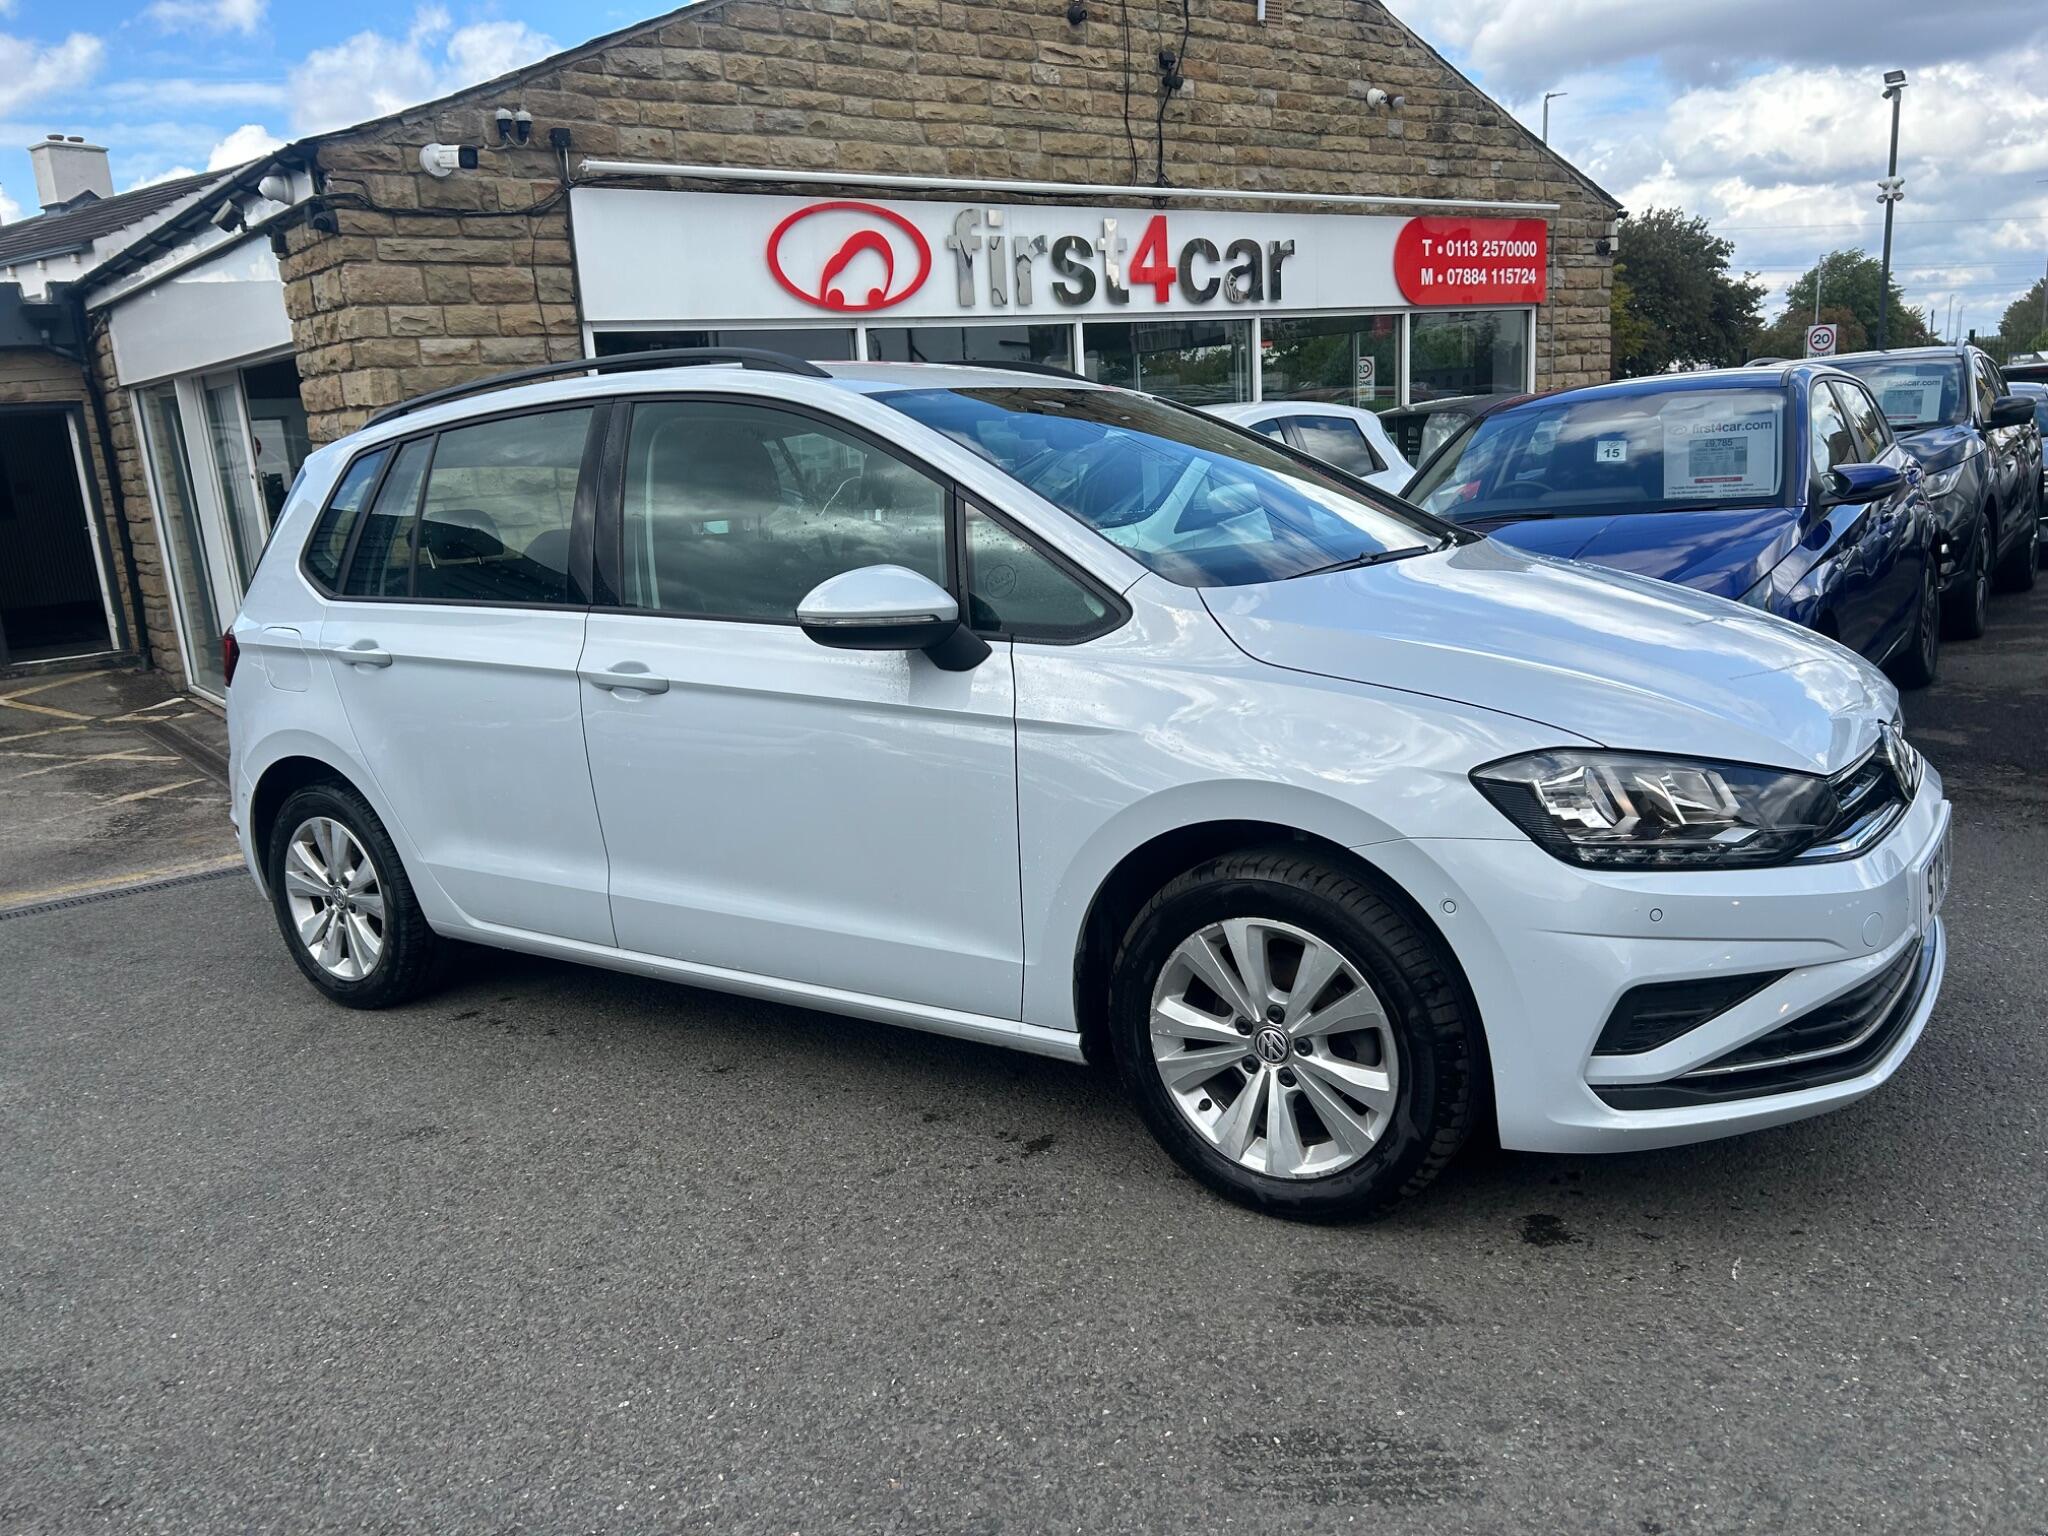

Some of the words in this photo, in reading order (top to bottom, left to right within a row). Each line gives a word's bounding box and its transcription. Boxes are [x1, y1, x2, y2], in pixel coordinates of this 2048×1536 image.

[1422, 239, 1433, 257] T
[1446, 240, 1478, 257] 0113
[1482, 240, 1537, 257] 2570000
[947, 208, 1295, 307] first4car
[1420, 268, 1433, 286] M
[1446, 268, 1487, 286] 07884
[1491, 267, 1537, 285] 115724
[1813, 333, 1830, 345] 20
[1692, 420, 1773, 434] first4car.com
[1604, 448, 1620, 458] 15
